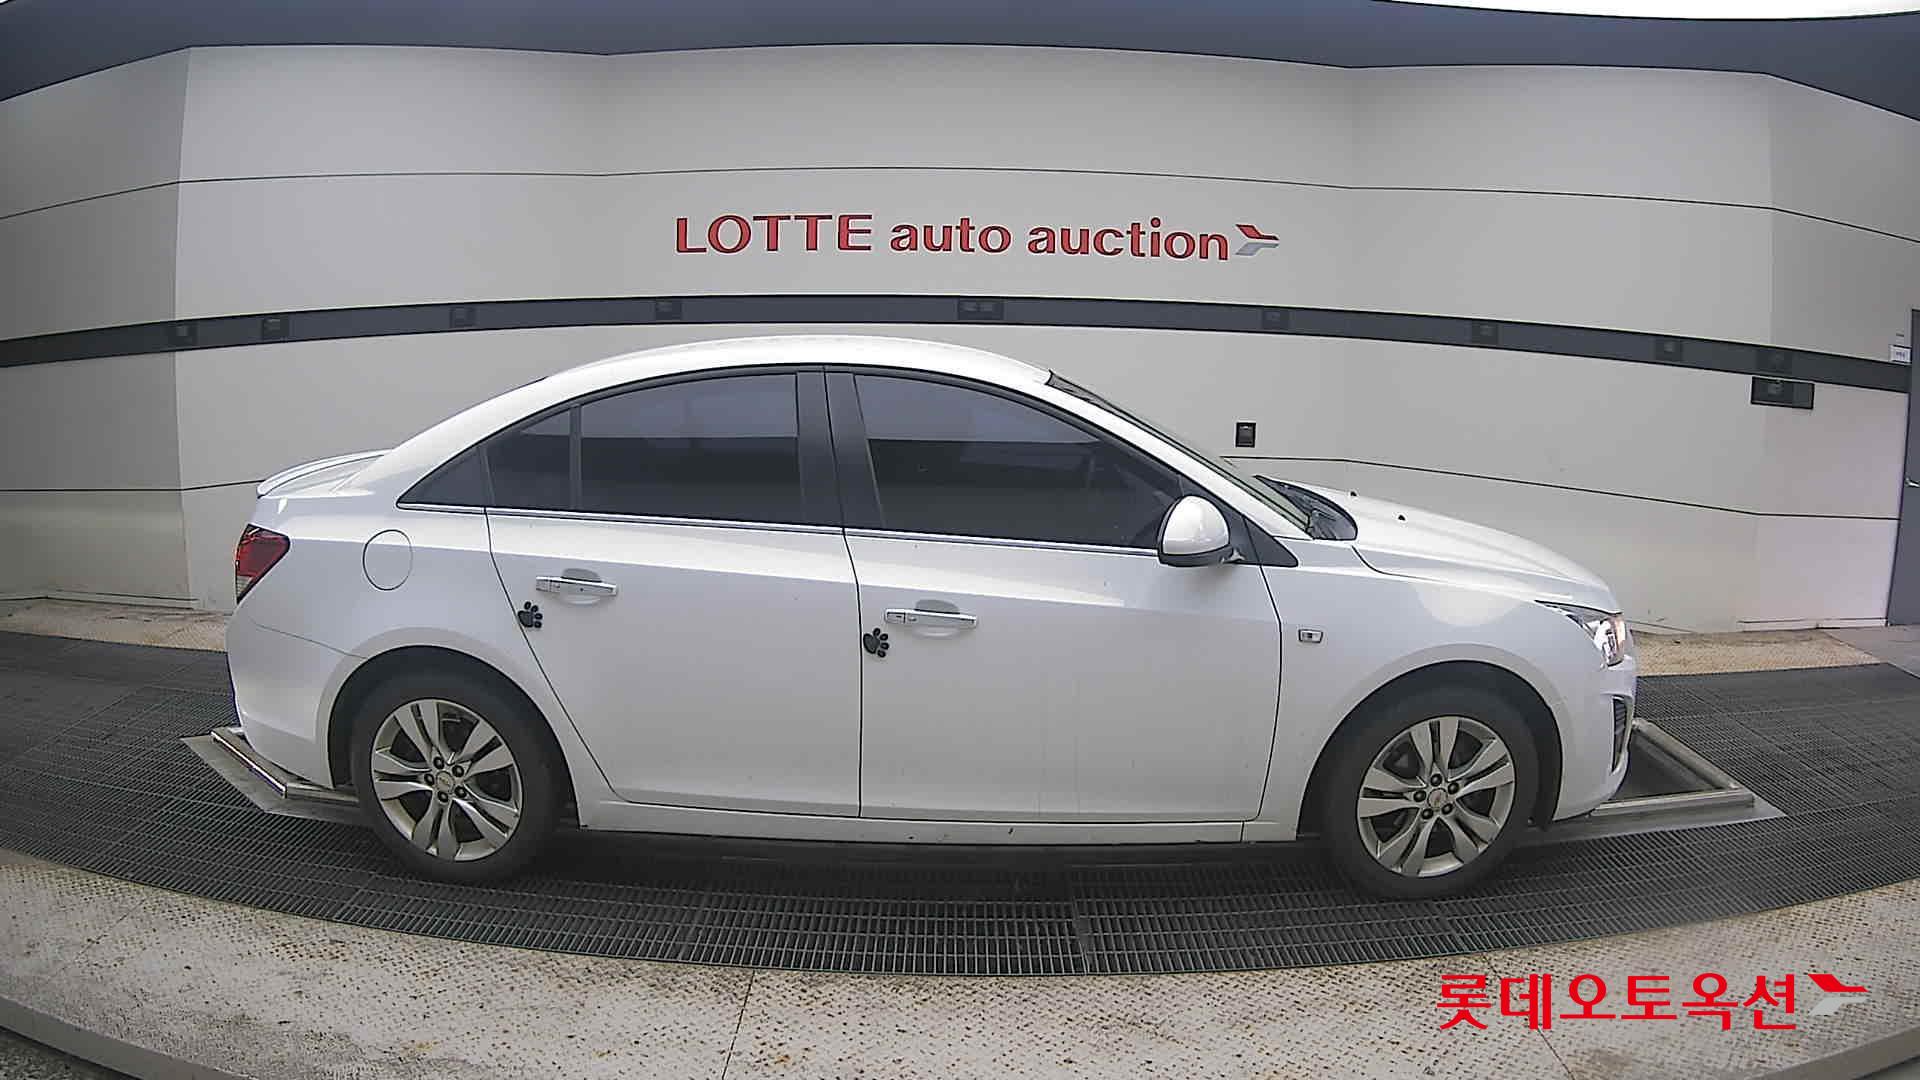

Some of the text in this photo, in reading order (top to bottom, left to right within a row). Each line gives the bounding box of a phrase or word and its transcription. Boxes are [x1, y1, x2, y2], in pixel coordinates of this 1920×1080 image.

[677, 214, 1229, 261] LOTTE auto auction
